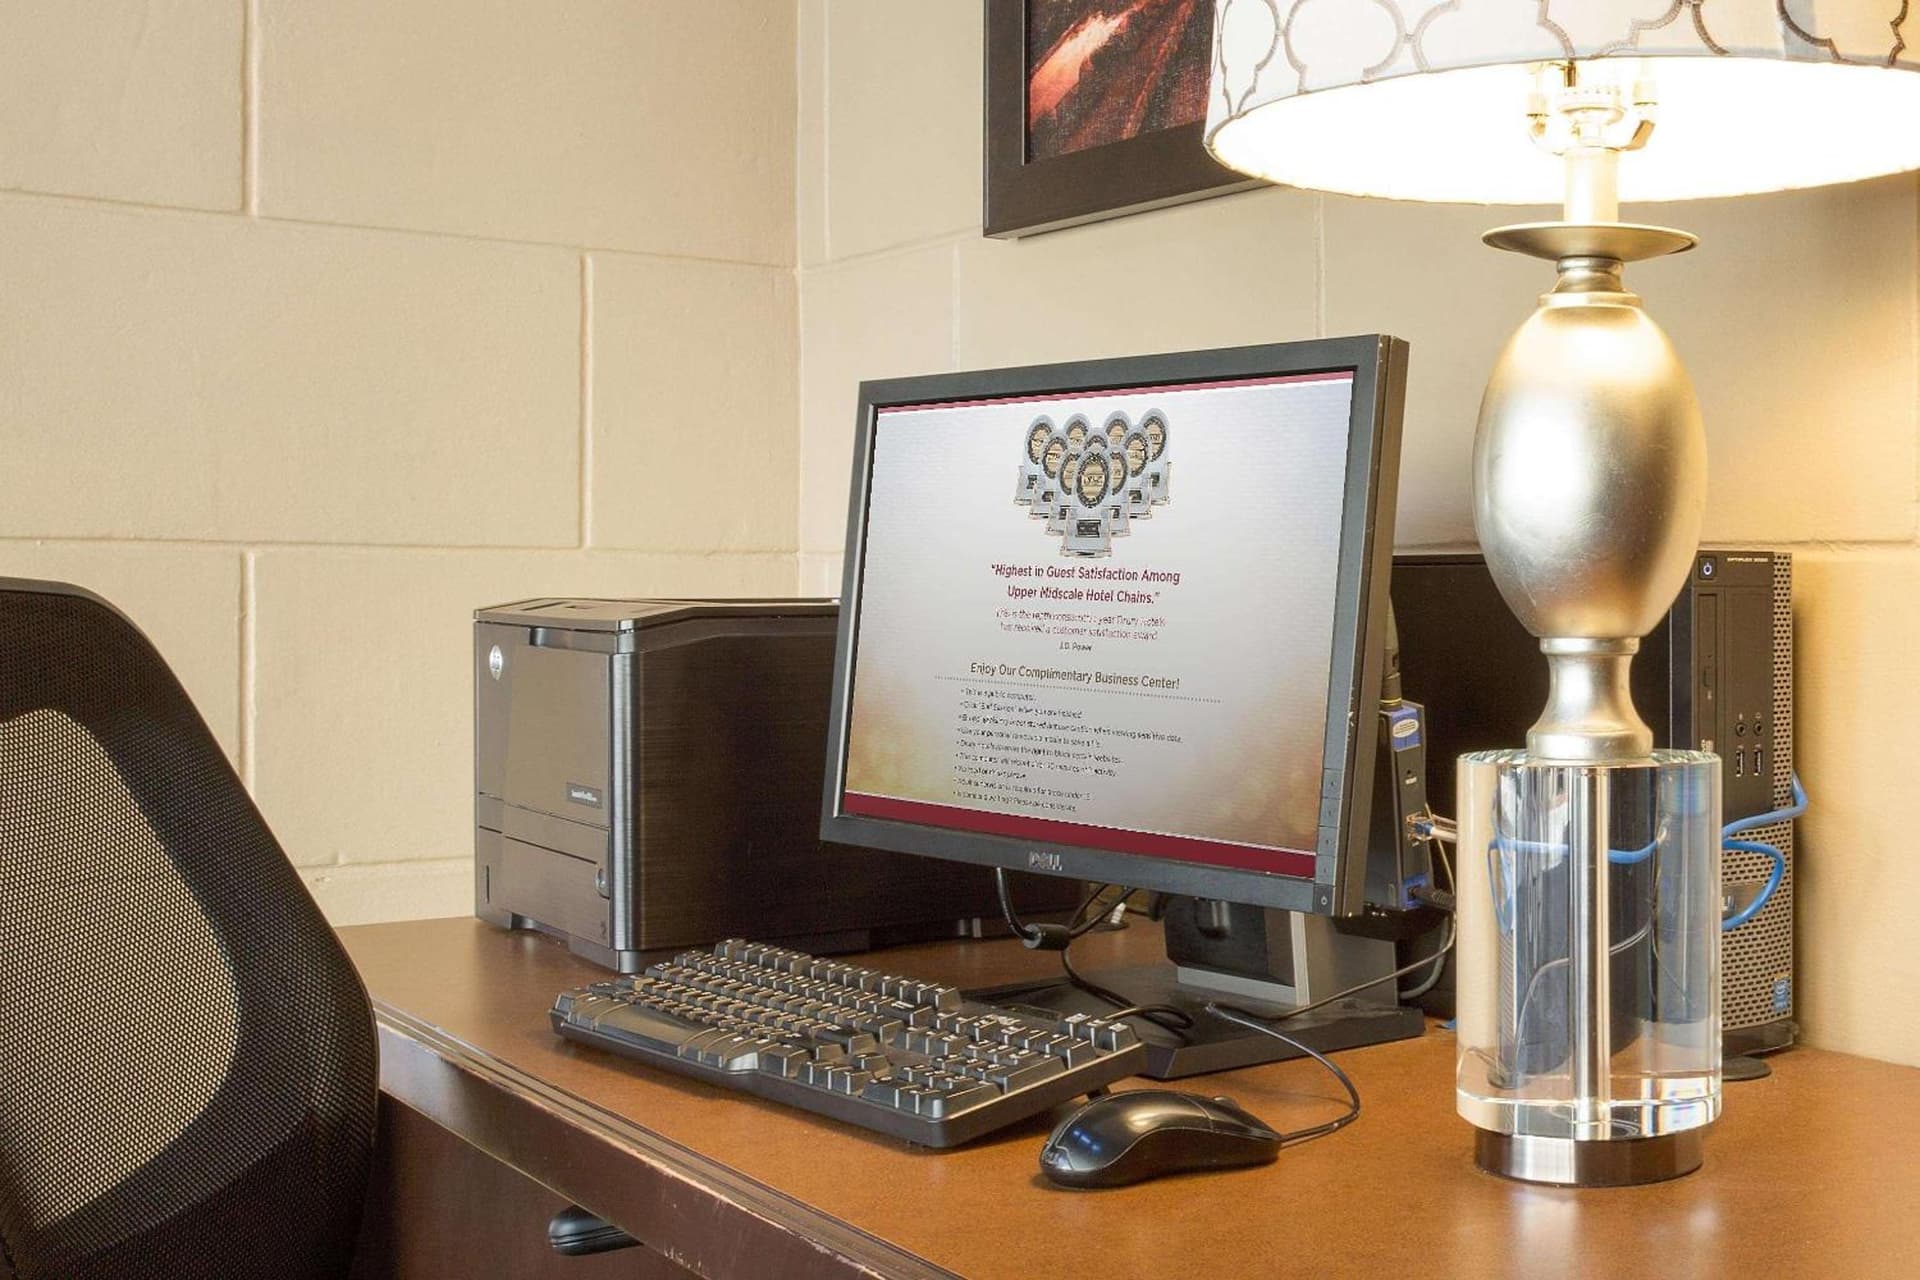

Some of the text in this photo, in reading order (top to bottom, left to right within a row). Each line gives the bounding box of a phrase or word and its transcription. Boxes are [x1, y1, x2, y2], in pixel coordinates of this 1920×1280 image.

[1035, 565, 1043, 577] in
[1046, 566, 1075, 578] Guest
[1078, 566, 1138, 581] Satisfaction
[1141, 569, 1181, 586] Among
[1007, 585, 1037, 598] Upper
[1040, 586, 1083, 600] Midscale
[1086, 589, 1113, 602] Hotel
[970, 662, 1180, 690] Enjoy Our Complimentary Business Center!
